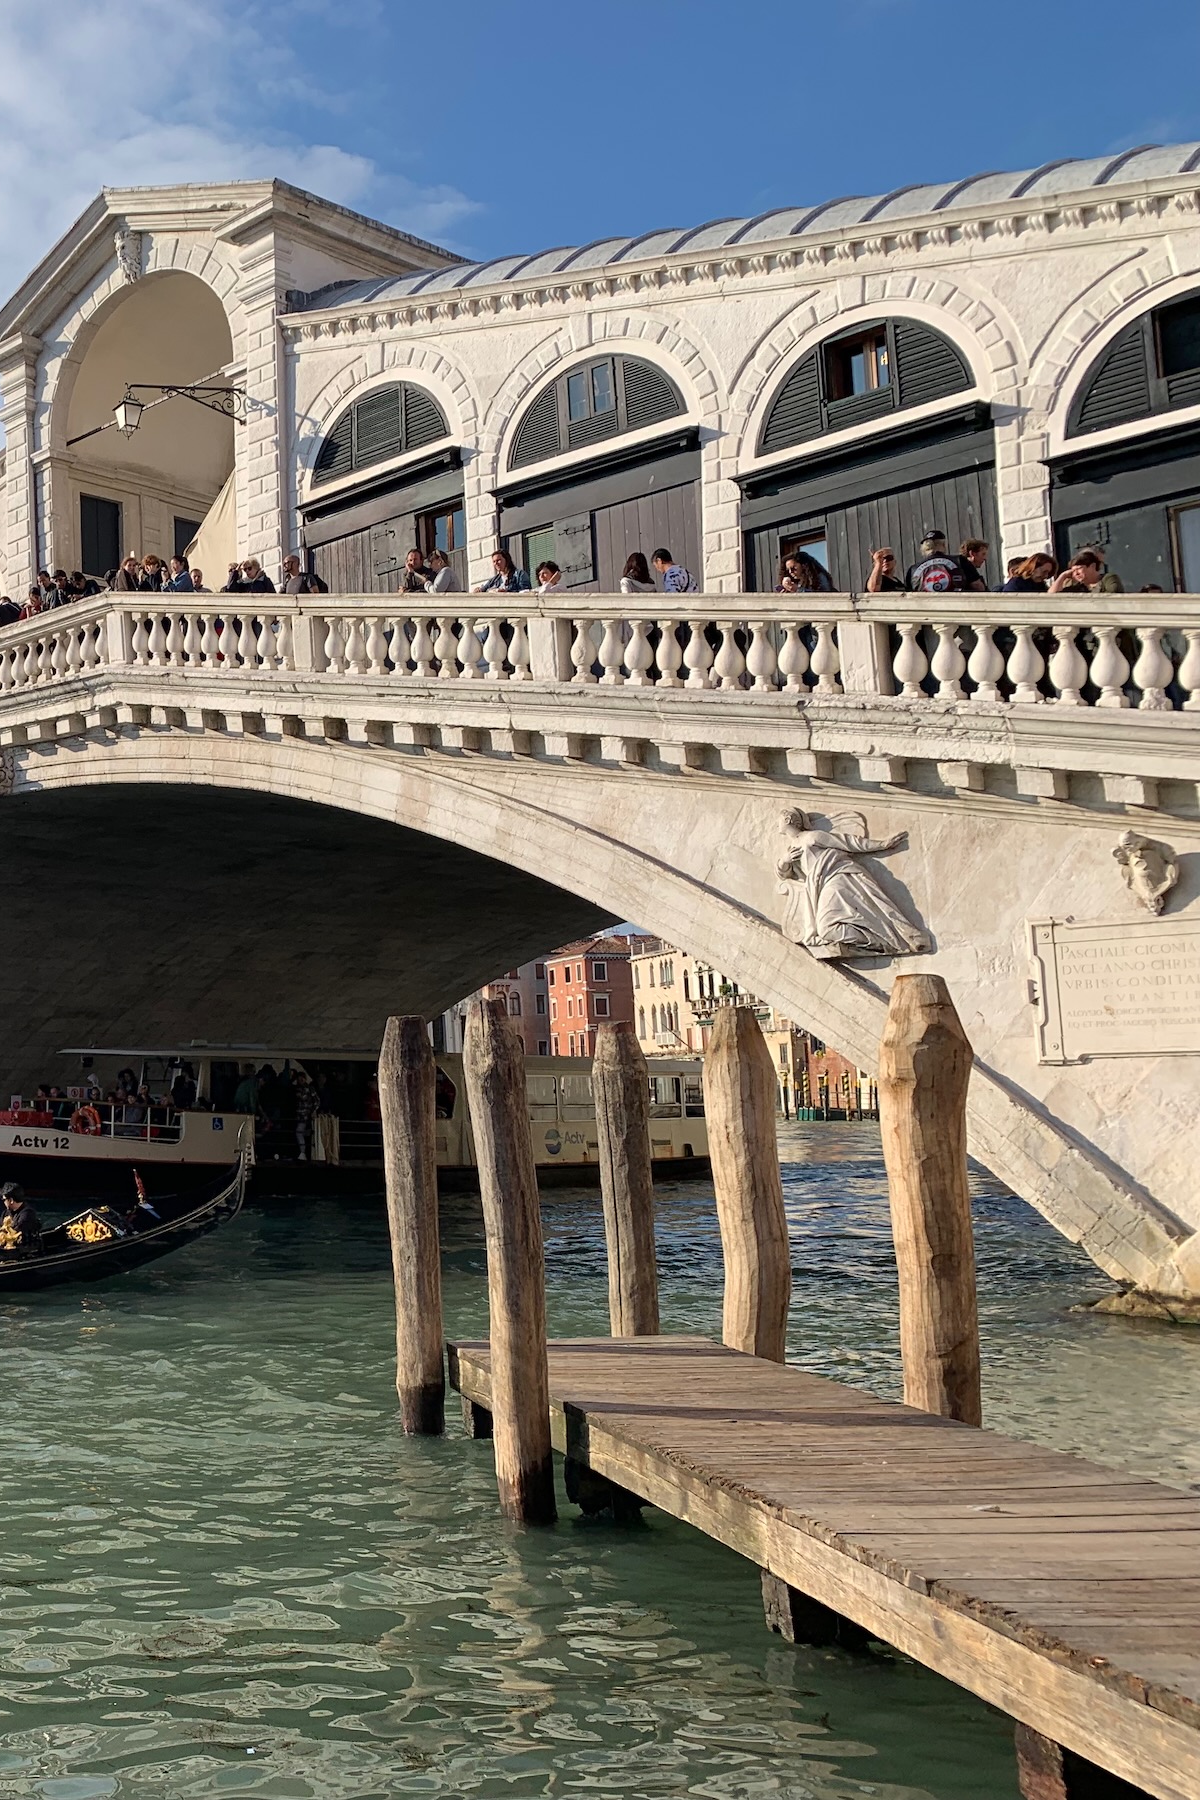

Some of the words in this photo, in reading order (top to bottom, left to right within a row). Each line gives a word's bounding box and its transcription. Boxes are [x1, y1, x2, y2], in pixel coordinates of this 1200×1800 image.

[11, 1135, 48, 1148] Actv
[52, 1137, 70, 1149] 12
[564, 1131, 585, 1144] Actv
